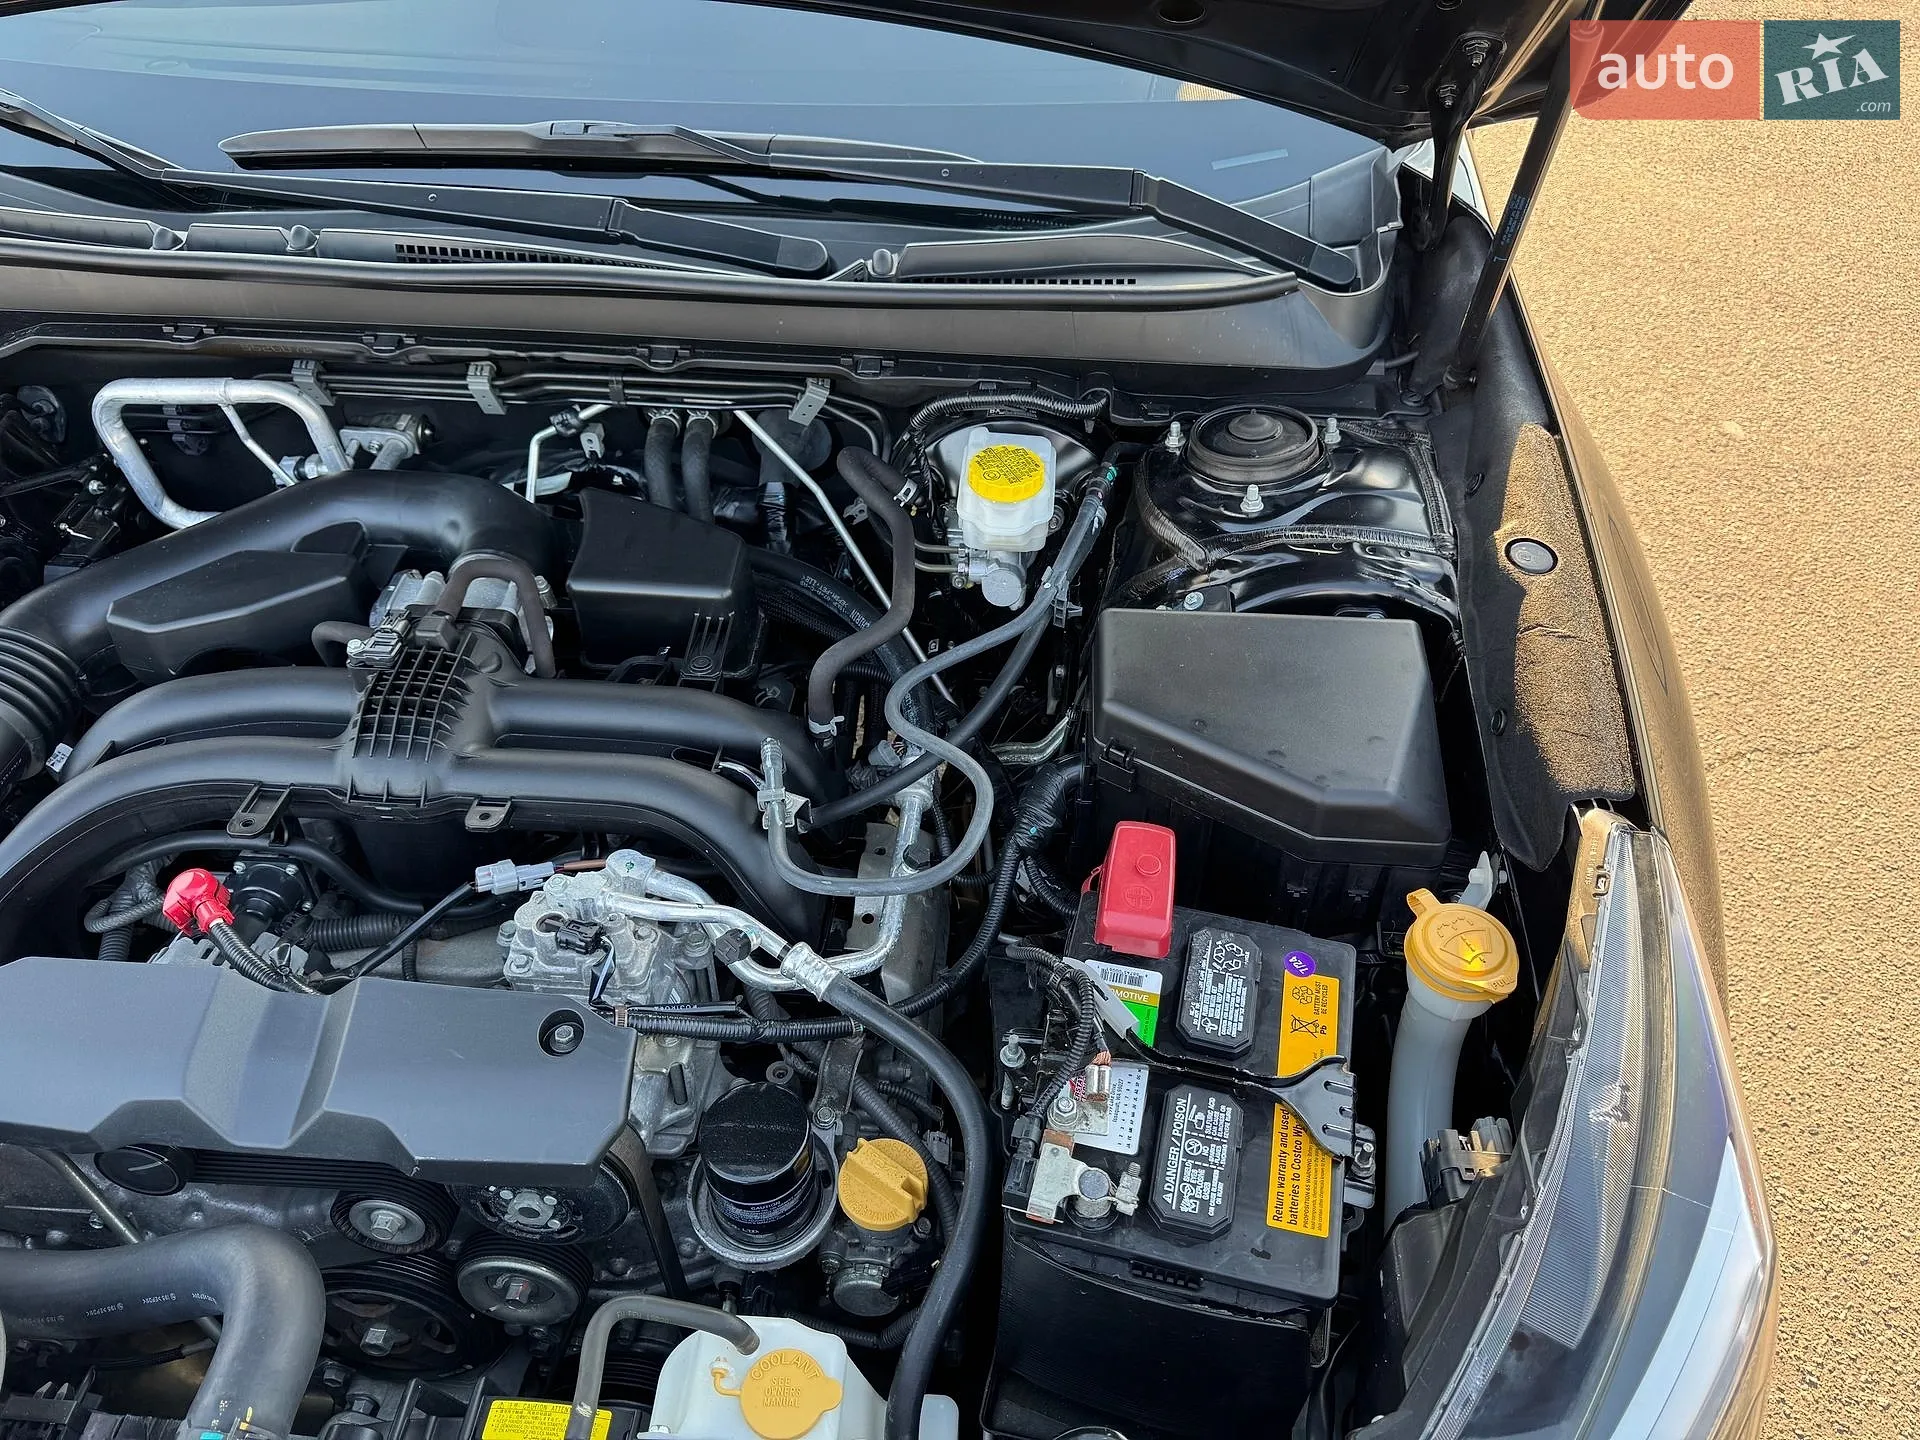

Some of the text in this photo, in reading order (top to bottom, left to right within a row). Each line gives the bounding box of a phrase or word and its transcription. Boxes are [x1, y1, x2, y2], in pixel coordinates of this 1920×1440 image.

[1289, 956, 1309, 974] 7/24
[1110, 988, 1149, 1002] MOTIVE
[1319, 1024, 1327, 1035] Pb
[1164, 1146, 1180, 1191] DANGER
[1172, 1098, 1186, 1136] POISON
[1290, 1139, 1302, 1170] Costco
[1272, 1108, 1290, 1222] Return warranty and used
[1290, 1172, 1300, 1181] to
[1286, 1184, 1299, 1225] batteries
[750, 1351, 820, 1380] COOLANT
[771, 1375, 791, 1386] SEE
[762, 1396, 800, 1408] MANUAL
